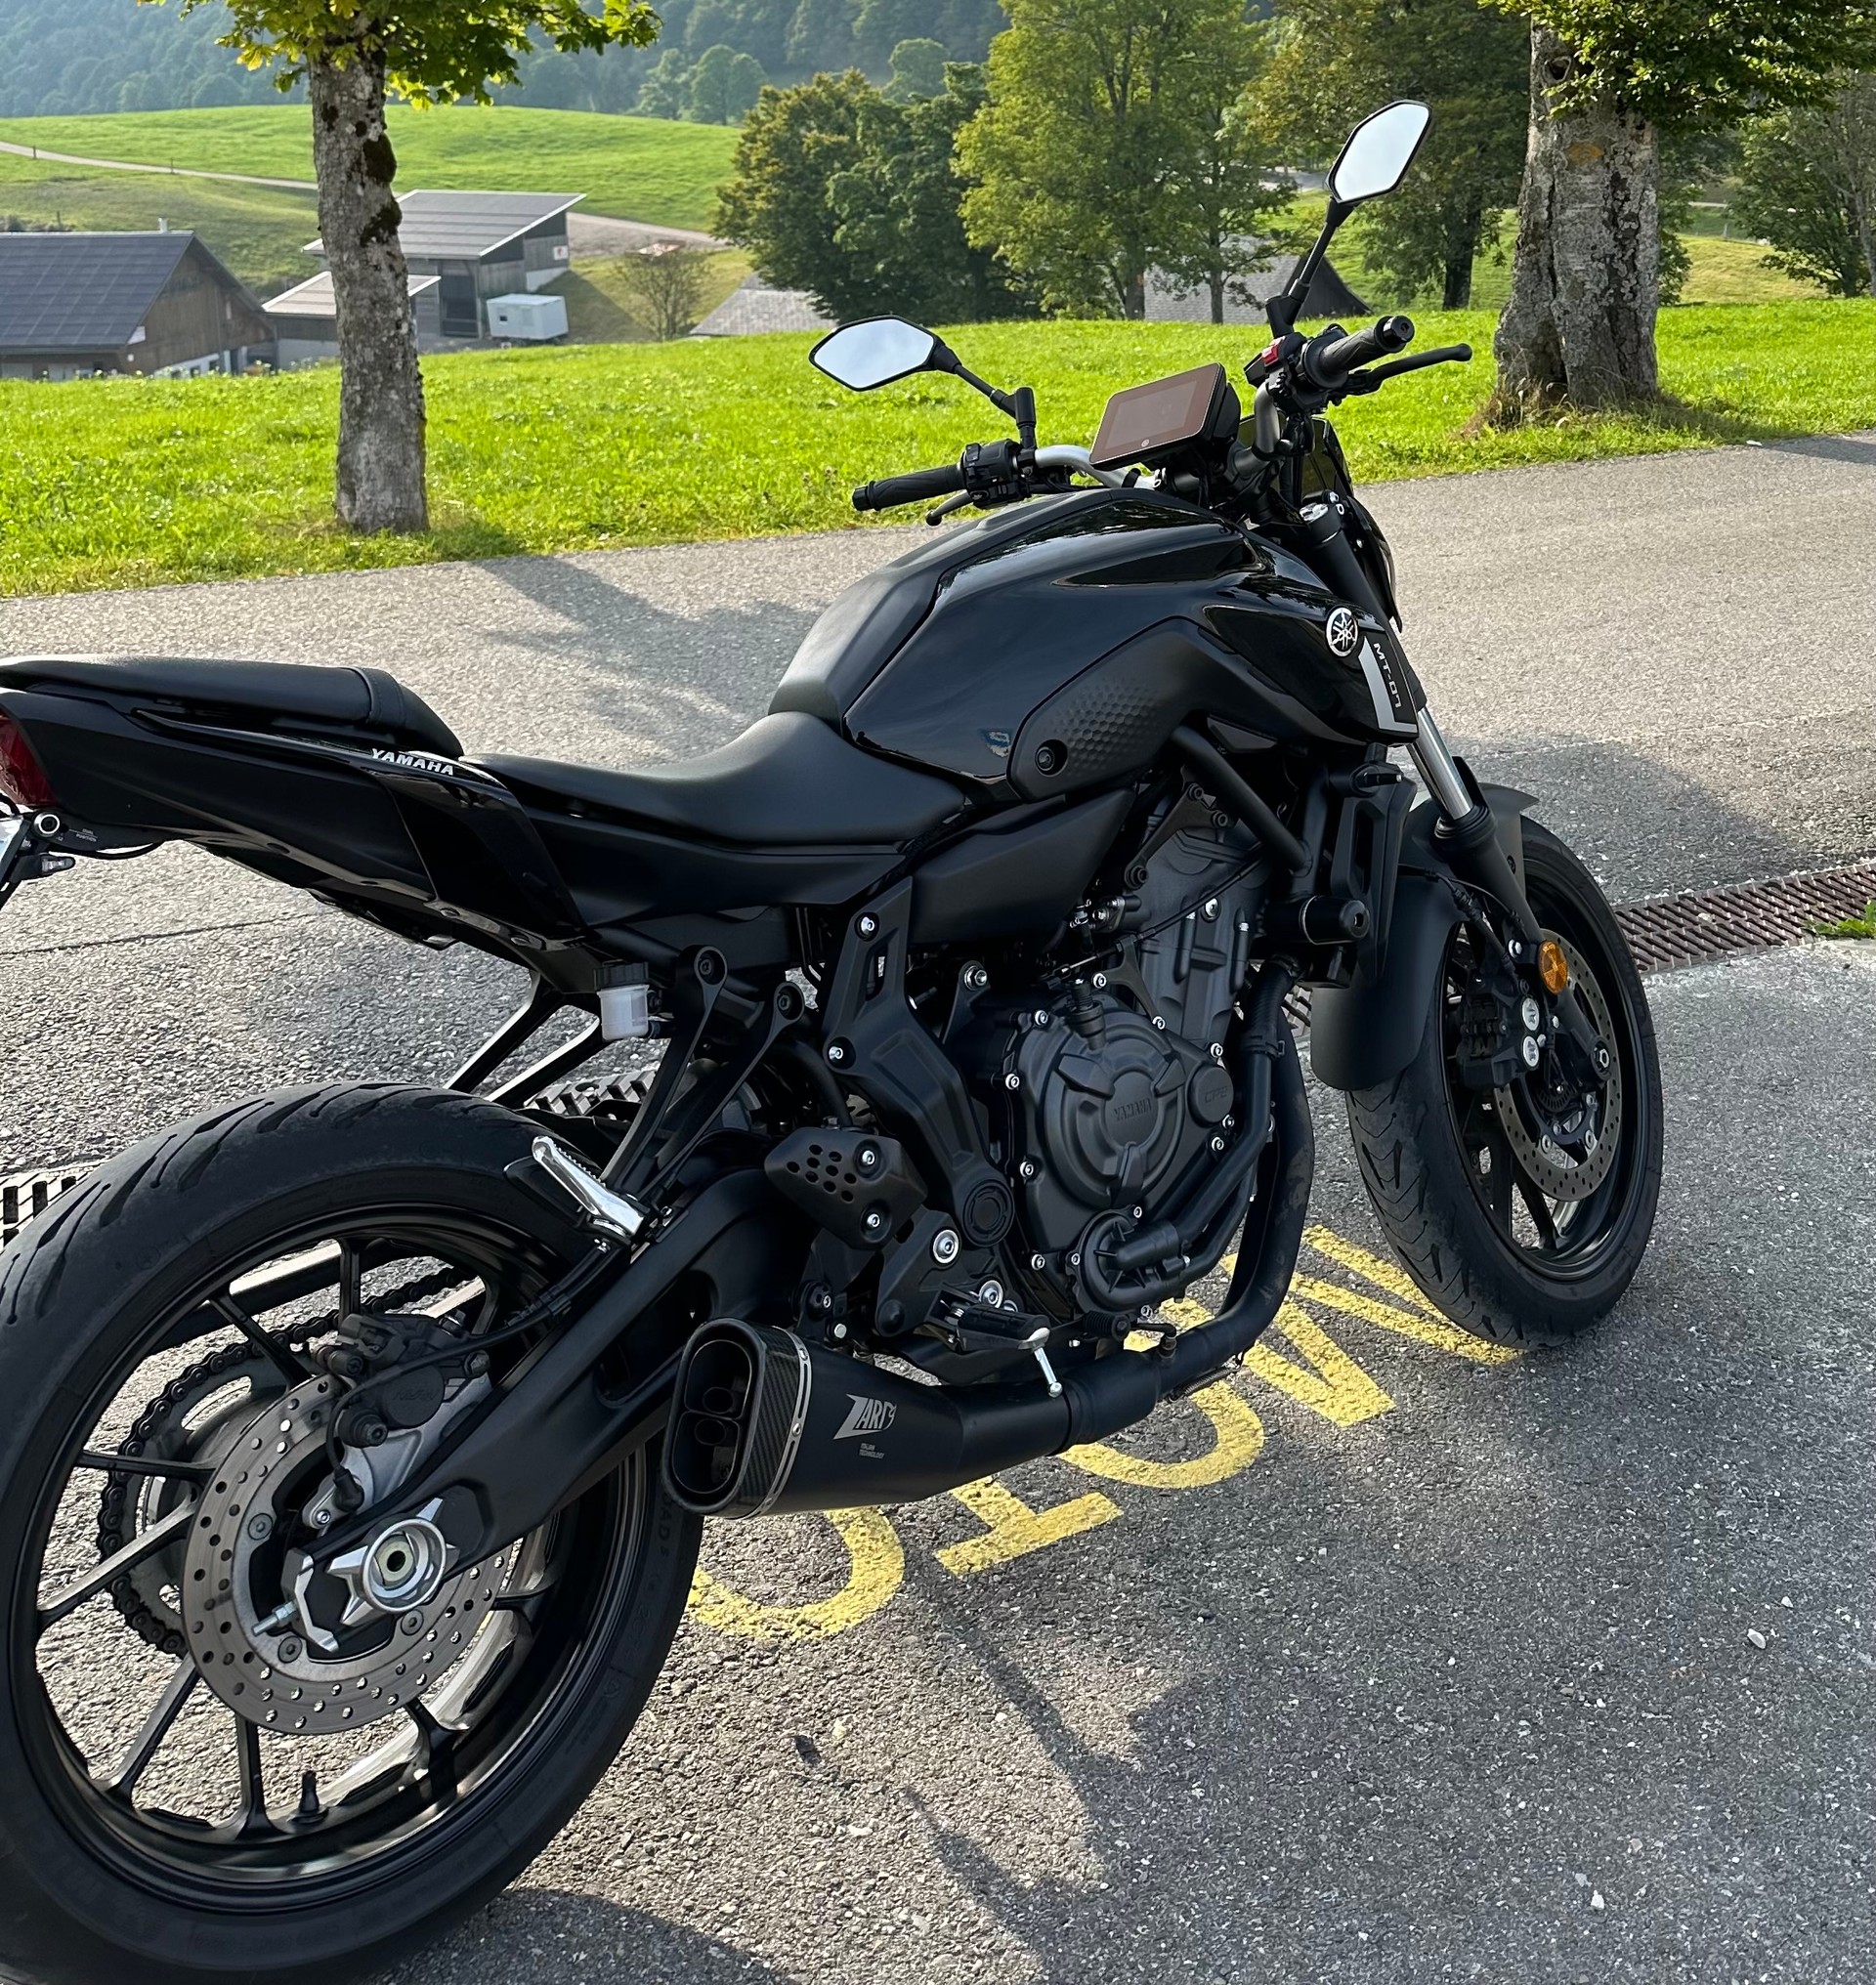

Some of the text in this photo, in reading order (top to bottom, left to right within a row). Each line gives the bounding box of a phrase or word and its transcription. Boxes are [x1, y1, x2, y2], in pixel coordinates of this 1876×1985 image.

[1373, 643, 1402, 708] MT-07
[371, 747, 453, 777] YAMAHA
[1113, 1098, 1153, 1120] YAMAHA
